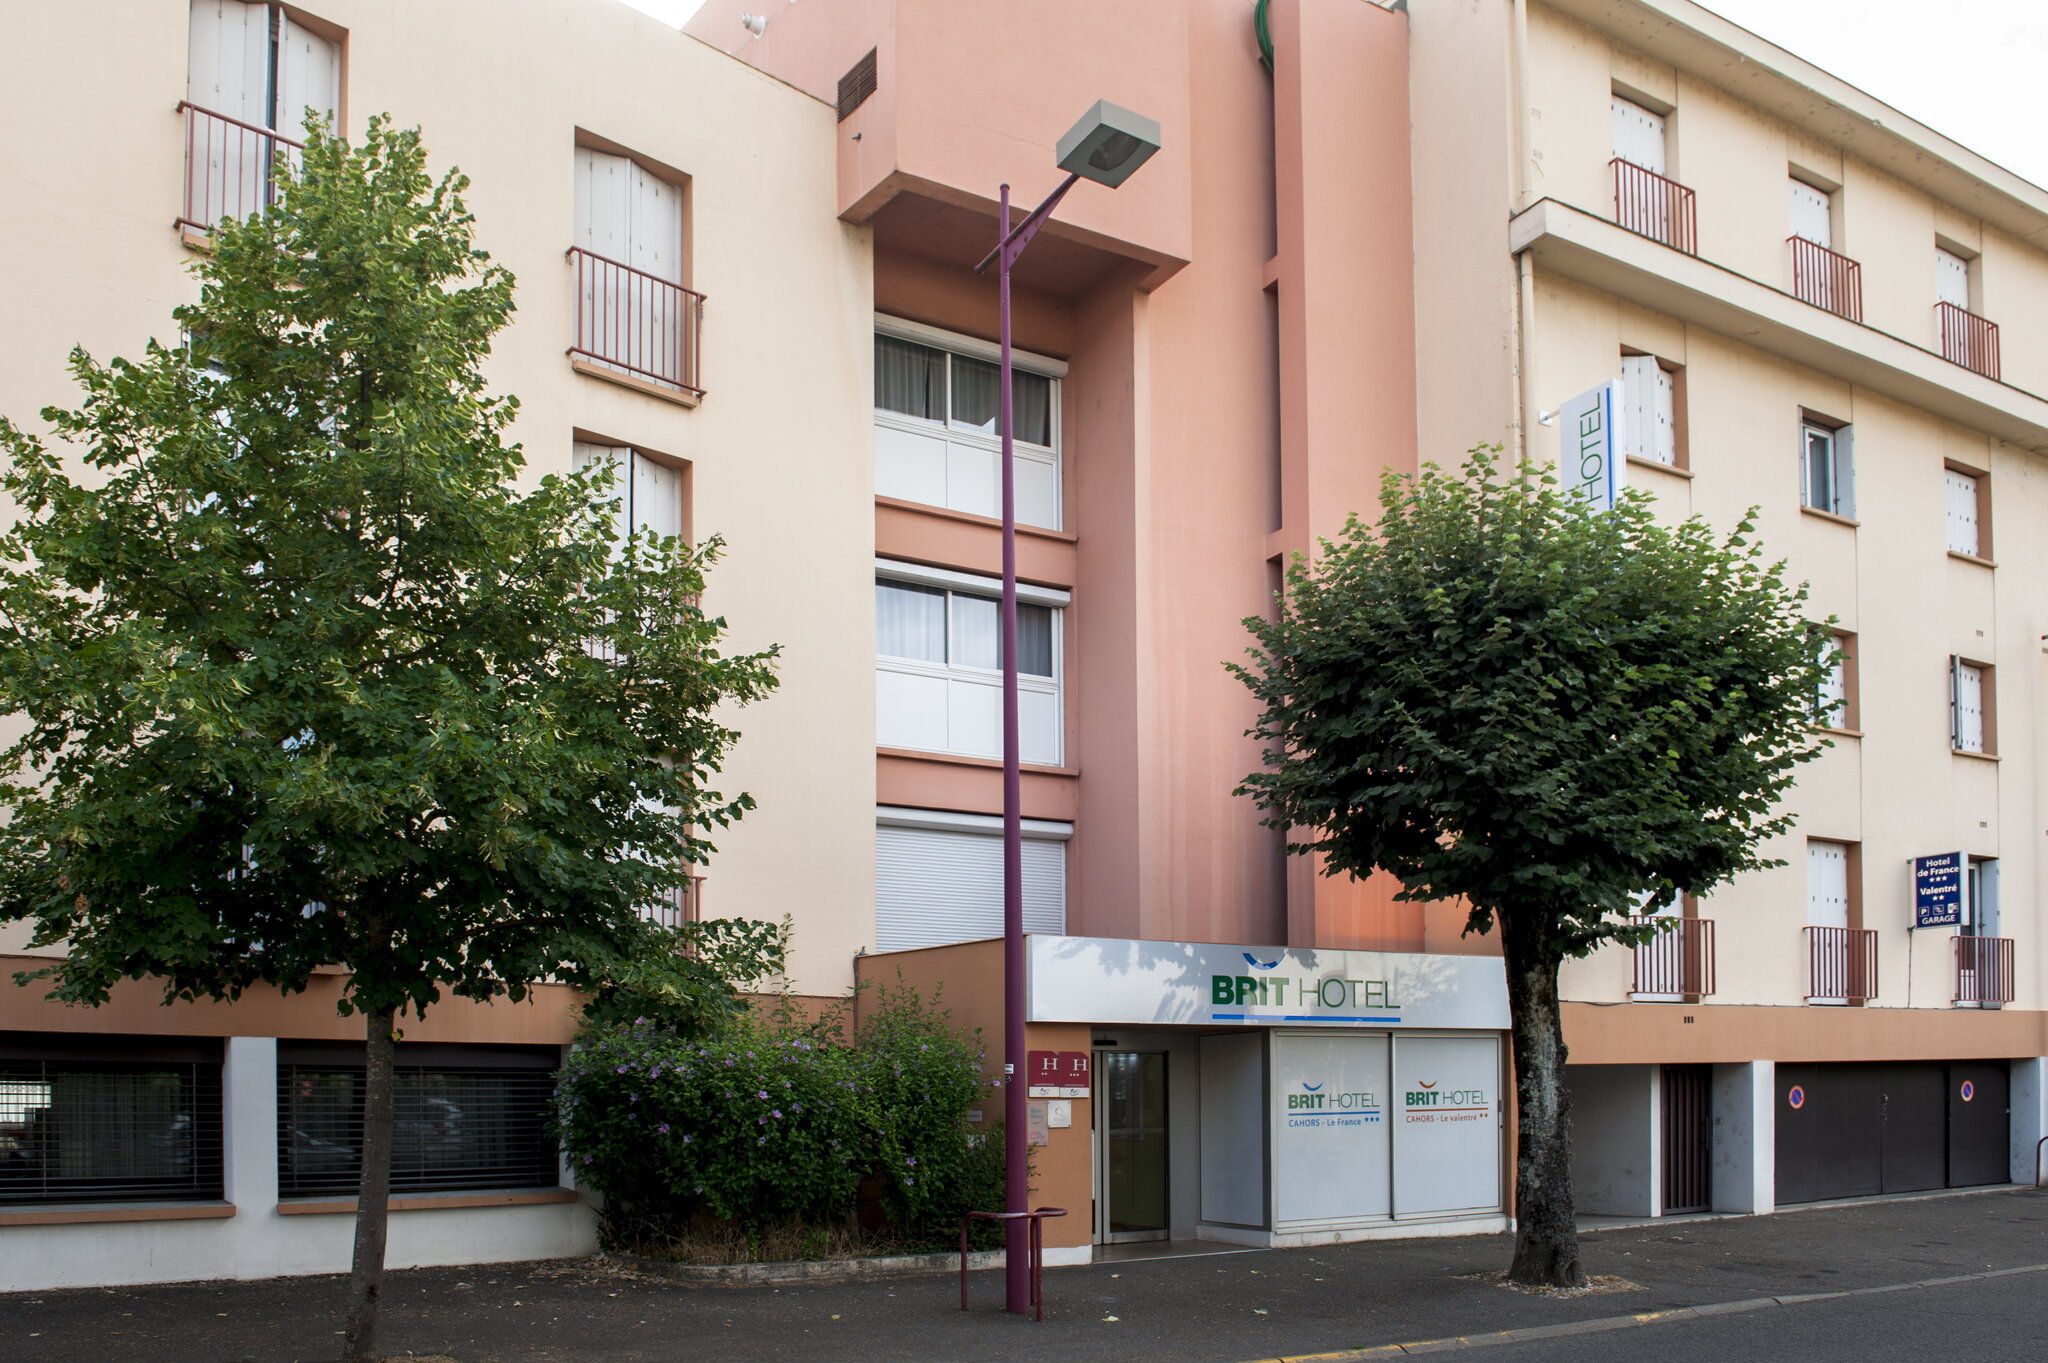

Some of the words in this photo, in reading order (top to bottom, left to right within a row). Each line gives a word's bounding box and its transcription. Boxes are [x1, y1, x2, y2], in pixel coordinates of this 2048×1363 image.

[1580, 392, 1602, 503] HOTEL
[1926, 857, 1950, 867] Hotel
[1917, 869, 1929, 878] de
[1930, 866, 1959, 875] France
[1920, 884, 1957, 895] Valentré
[1922, 915, 1955, 924] GARAGE
[1212, 975, 1290, 1006] BRIT
[1299, 978, 1402, 1009] HOTEL
[1288, 1094, 1325, 1109] BRIT
[1329, 1092, 1380, 1109] HOTEL
[1405, 1091, 1440, 1106] BRIT
[1442, 1090, 1489, 1105] HOTEL
[1288, 1119, 1320, 1128] CAHORS
[1326, 1118, 1335, 1126] Le
[1337, 1118, 1361, 1126] France
[1406, 1115, 1435, 1123] CAHORS
[1440, 1114, 1449, 1122] Le
